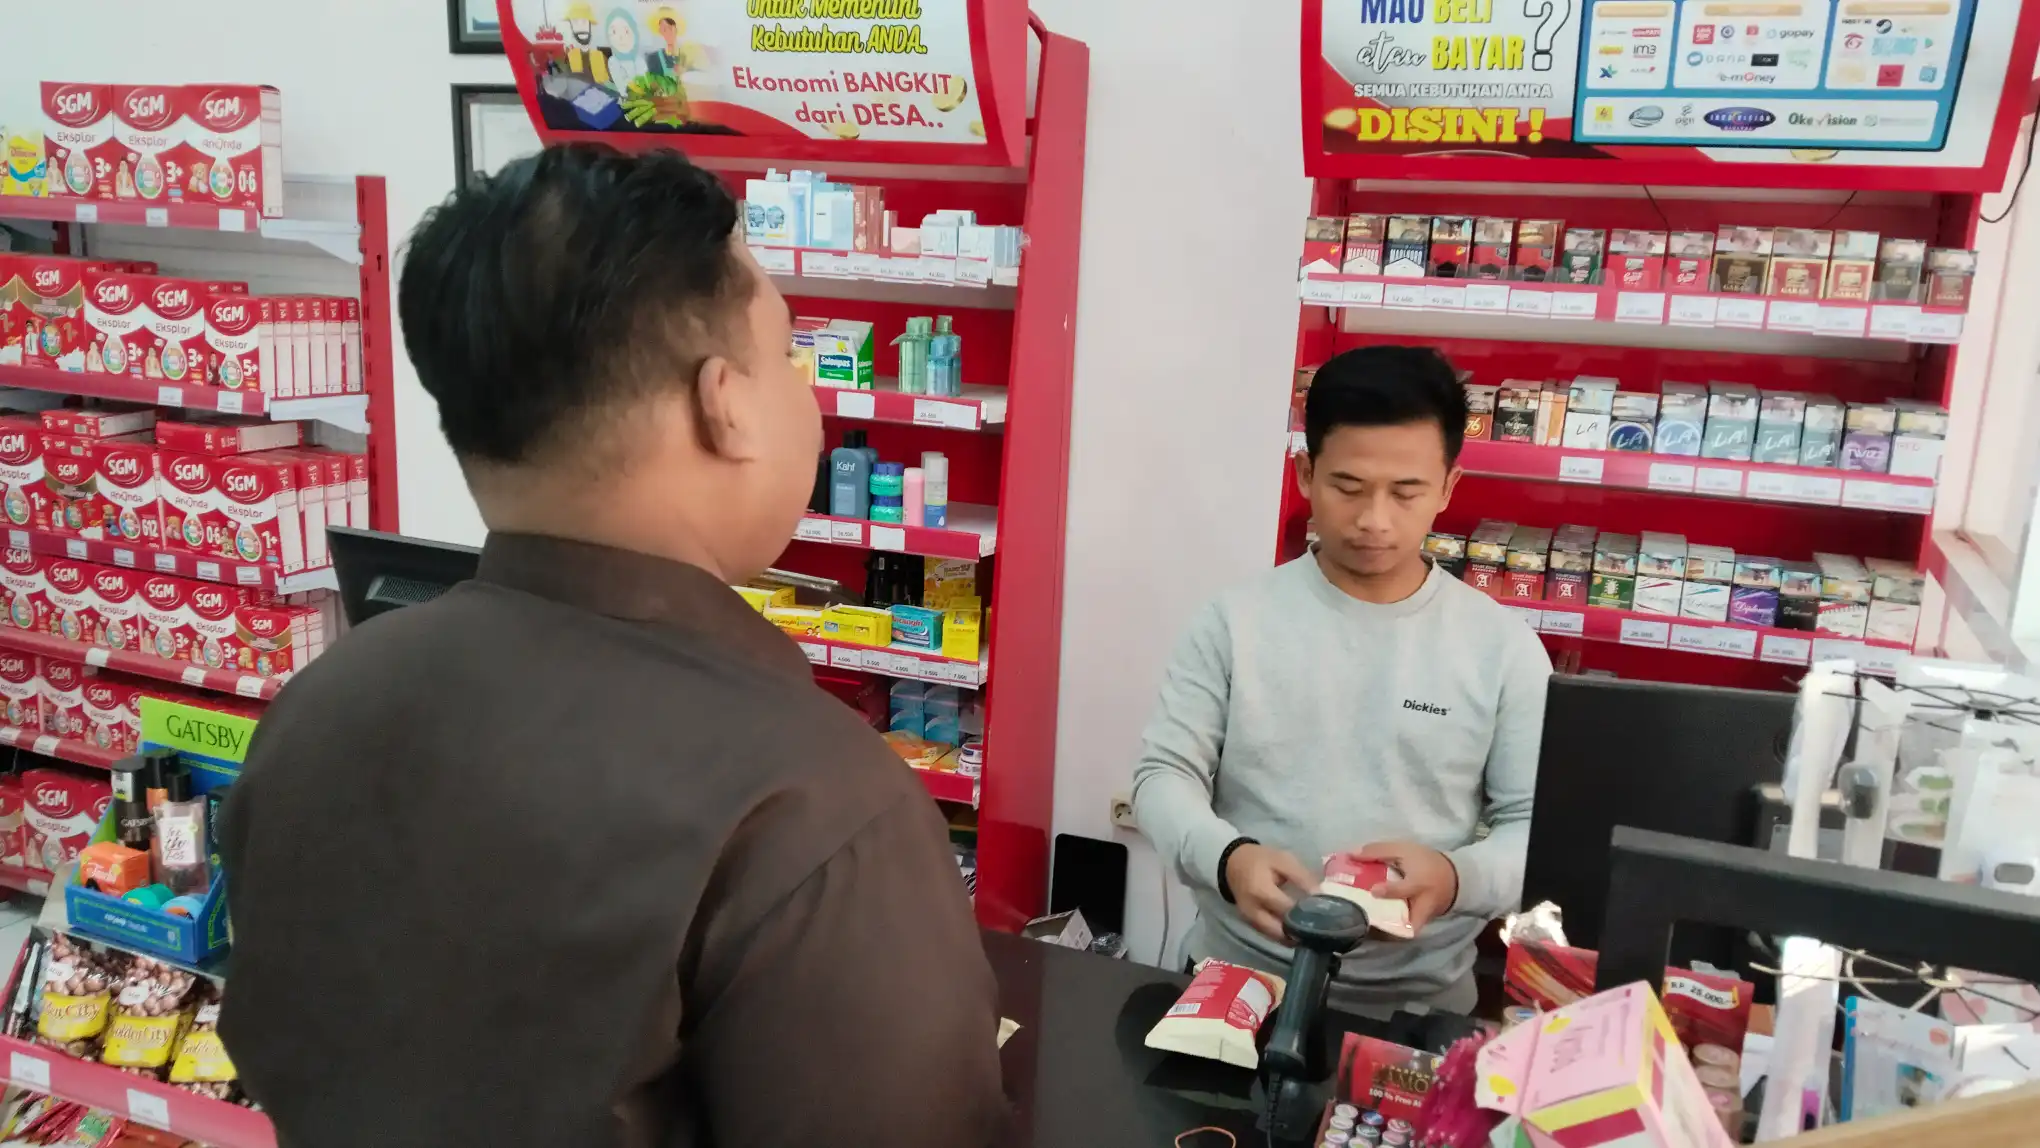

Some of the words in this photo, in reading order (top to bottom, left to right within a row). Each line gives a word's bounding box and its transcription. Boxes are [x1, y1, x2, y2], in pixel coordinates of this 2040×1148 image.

[1360, 0, 1425, 24] MAU
[1432, 0, 1495, 24] BELI
[751, 23, 864, 53] Kebutuhan
[1780, 28, 1815, 39] gopay
[1356, 30, 1427, 75] atau
[1432, 35, 1526, 72] BAYAR
[732, 66, 839, 92] Ekonomi
[843, 71, 951, 95] BANGKIT
[1353, 83, 1407, 98] SEMUA
[1410, 83, 1502, 98] KEBUTUHAN
[1505, 83, 1553, 98] ANDA
[57, 92, 92, 115] SGM
[129, 94, 165, 118] SGM
[205, 96, 240, 120] SGM
[795, 101, 846, 124] dari
[1356, 107, 1520, 144] DISINI
[57, 132, 96, 145] Eksplor
[95, 157, 112, 179] 3+
[166, 161, 183, 183] 3+
[35, 270, 60, 287] SGM
[98, 284, 128, 303] SGM
[157, 289, 188, 308] SGM
[215, 305, 244, 322] SGM
[155, 322, 192, 335] Eksplor
[128, 342, 143, 361] 3+
[187, 348, 203, 368] 3+
[243, 359, 258, 376] 5+
[1576, 421, 1598, 436] LA
[1616, 431, 1645, 447] LA
[1664, 429, 1693, 446] LA
[58, 464, 78, 477] SGM
[108, 458, 137, 476] SGM
[174, 463, 204, 481] SGM
[836, 461, 857, 472] Kahf
[226, 474, 257, 492] SGM
[31, 492, 47, 511] 1+
[228, 505, 263, 519] Eksplor
[261, 530, 278, 549] 1+
[6, 549, 32, 564] SGM
[53, 568, 78, 582] SGM
[97, 576, 123, 591] SGM
[148, 584, 175, 598] SGM
[34, 600, 48, 617] 1+
[195, 594, 222, 608] SGM
[80, 614, 93, 629] 1+
[252, 619, 273, 630] SGM
[125, 624, 138, 640] 3+
[175, 632, 189, 648] 3+
[223, 642, 237, 659] 3+
[1402, 699, 1448, 716] Dickies
[166, 714, 246, 756] GATSBY
[37, 789, 68, 807] SGM
